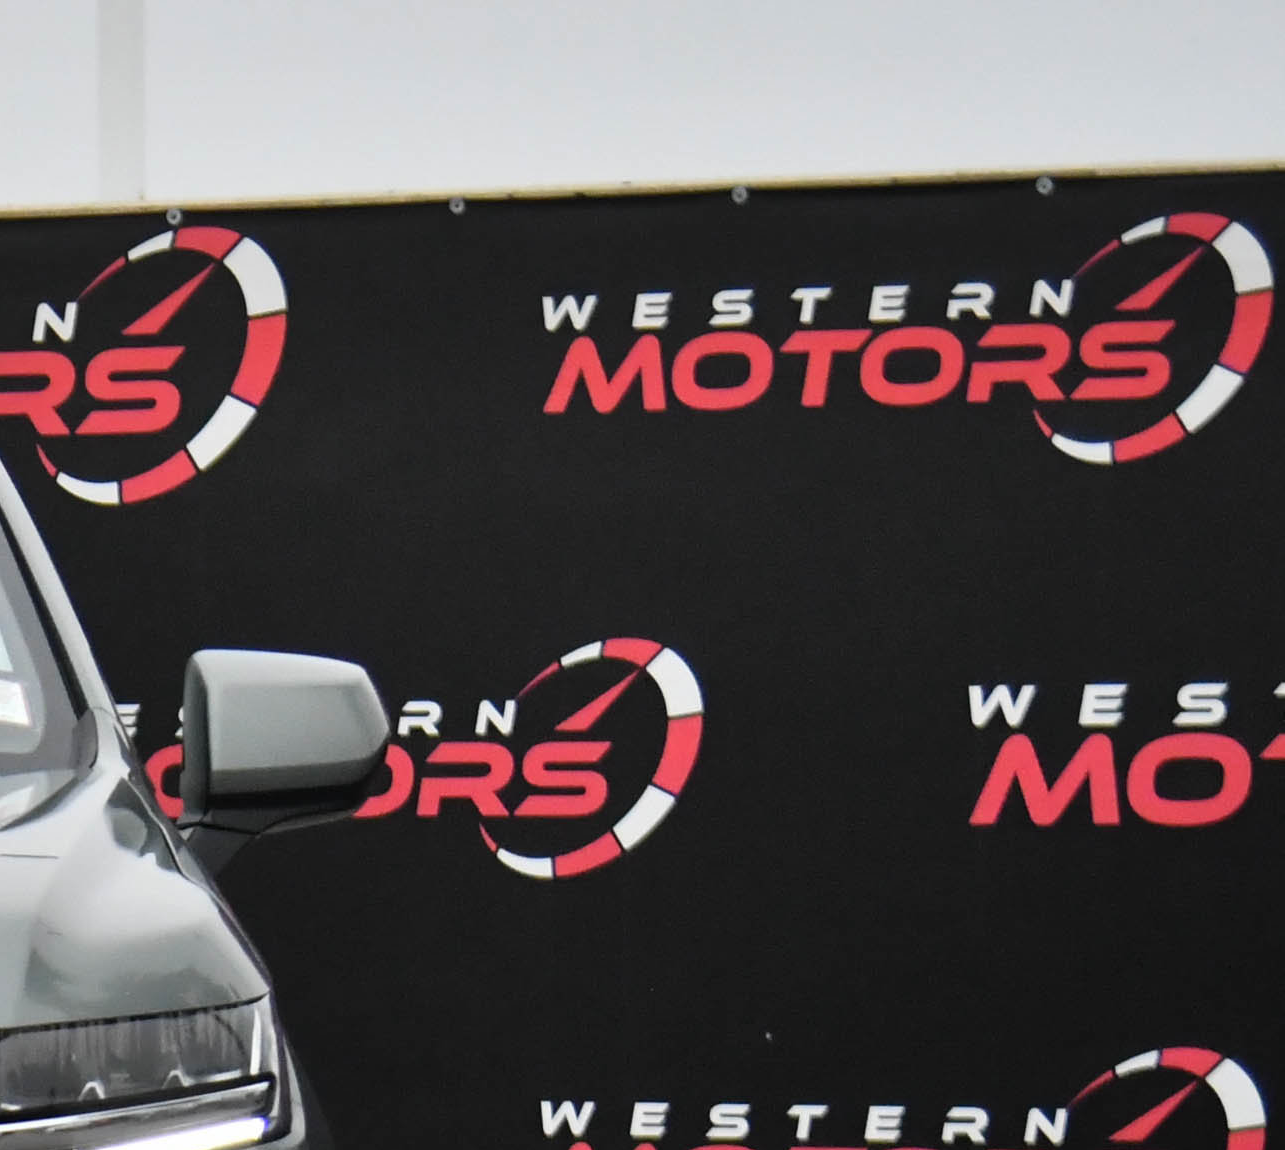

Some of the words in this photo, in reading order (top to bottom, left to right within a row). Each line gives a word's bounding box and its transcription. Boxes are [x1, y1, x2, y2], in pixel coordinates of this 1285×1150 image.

[542, 278, 1074, 330] WESTERN
[542, 320, 1176, 416] MOTORS
[540, 1100, 1069, 1145] WESTERN
